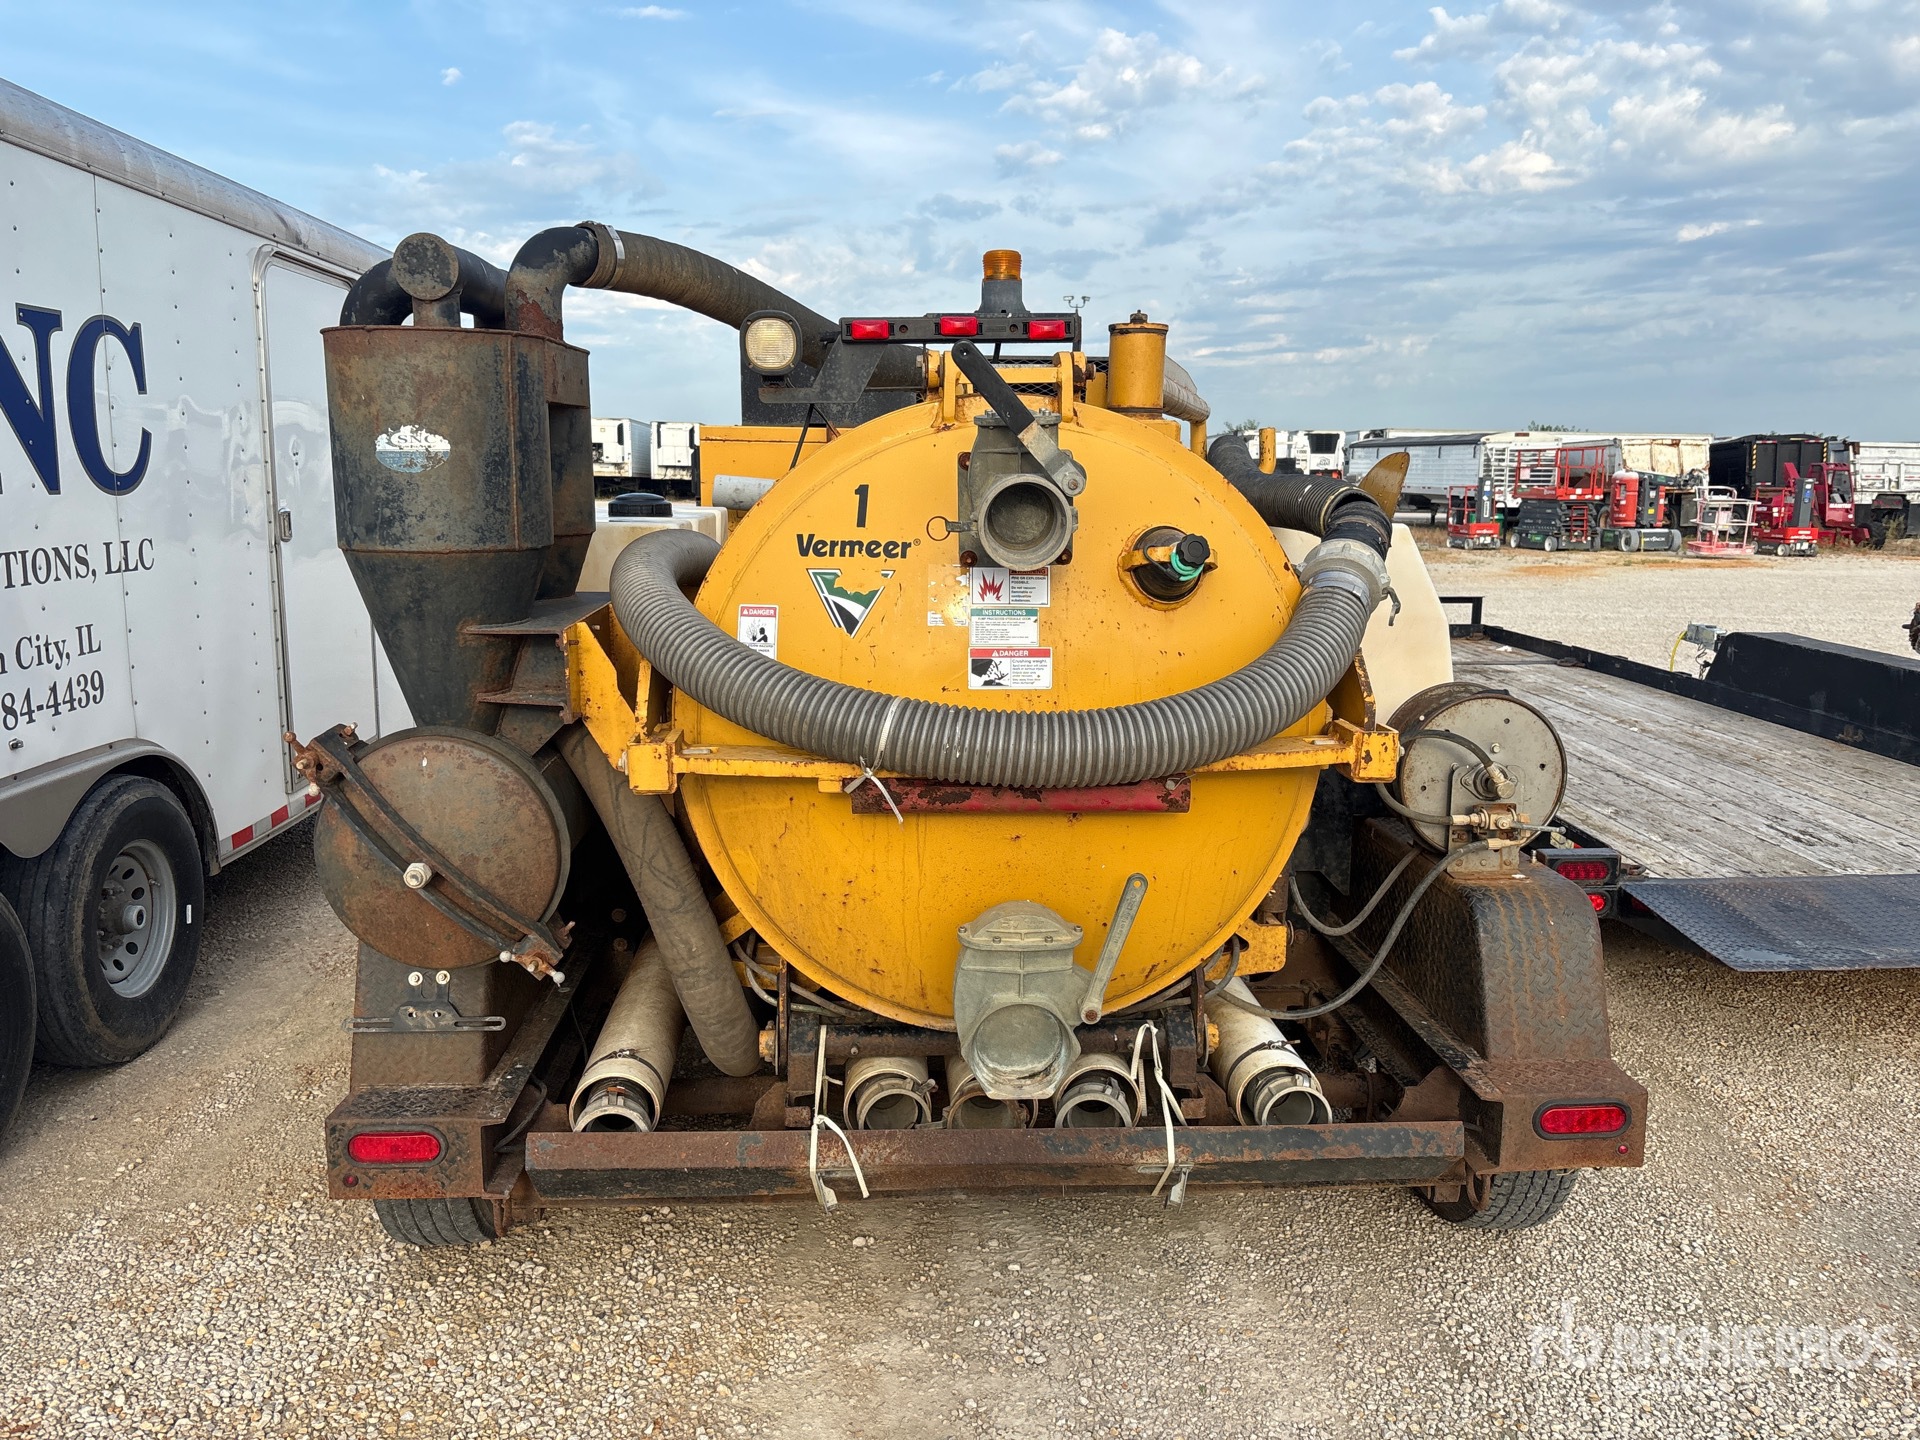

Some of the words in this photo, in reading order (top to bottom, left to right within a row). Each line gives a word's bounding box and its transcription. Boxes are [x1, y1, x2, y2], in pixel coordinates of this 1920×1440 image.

[397, 433, 437, 444] SNC
[855, 484, 869, 528] 1
[0, 543, 97, 589] TIONS,
[103, 538, 155, 575] LLC
[796, 533, 912, 559] Vermeer
[15, 634, 71, 670] City,
[76, 624, 102, 656] IL
[1, 670, 105, 731] 84-4439
